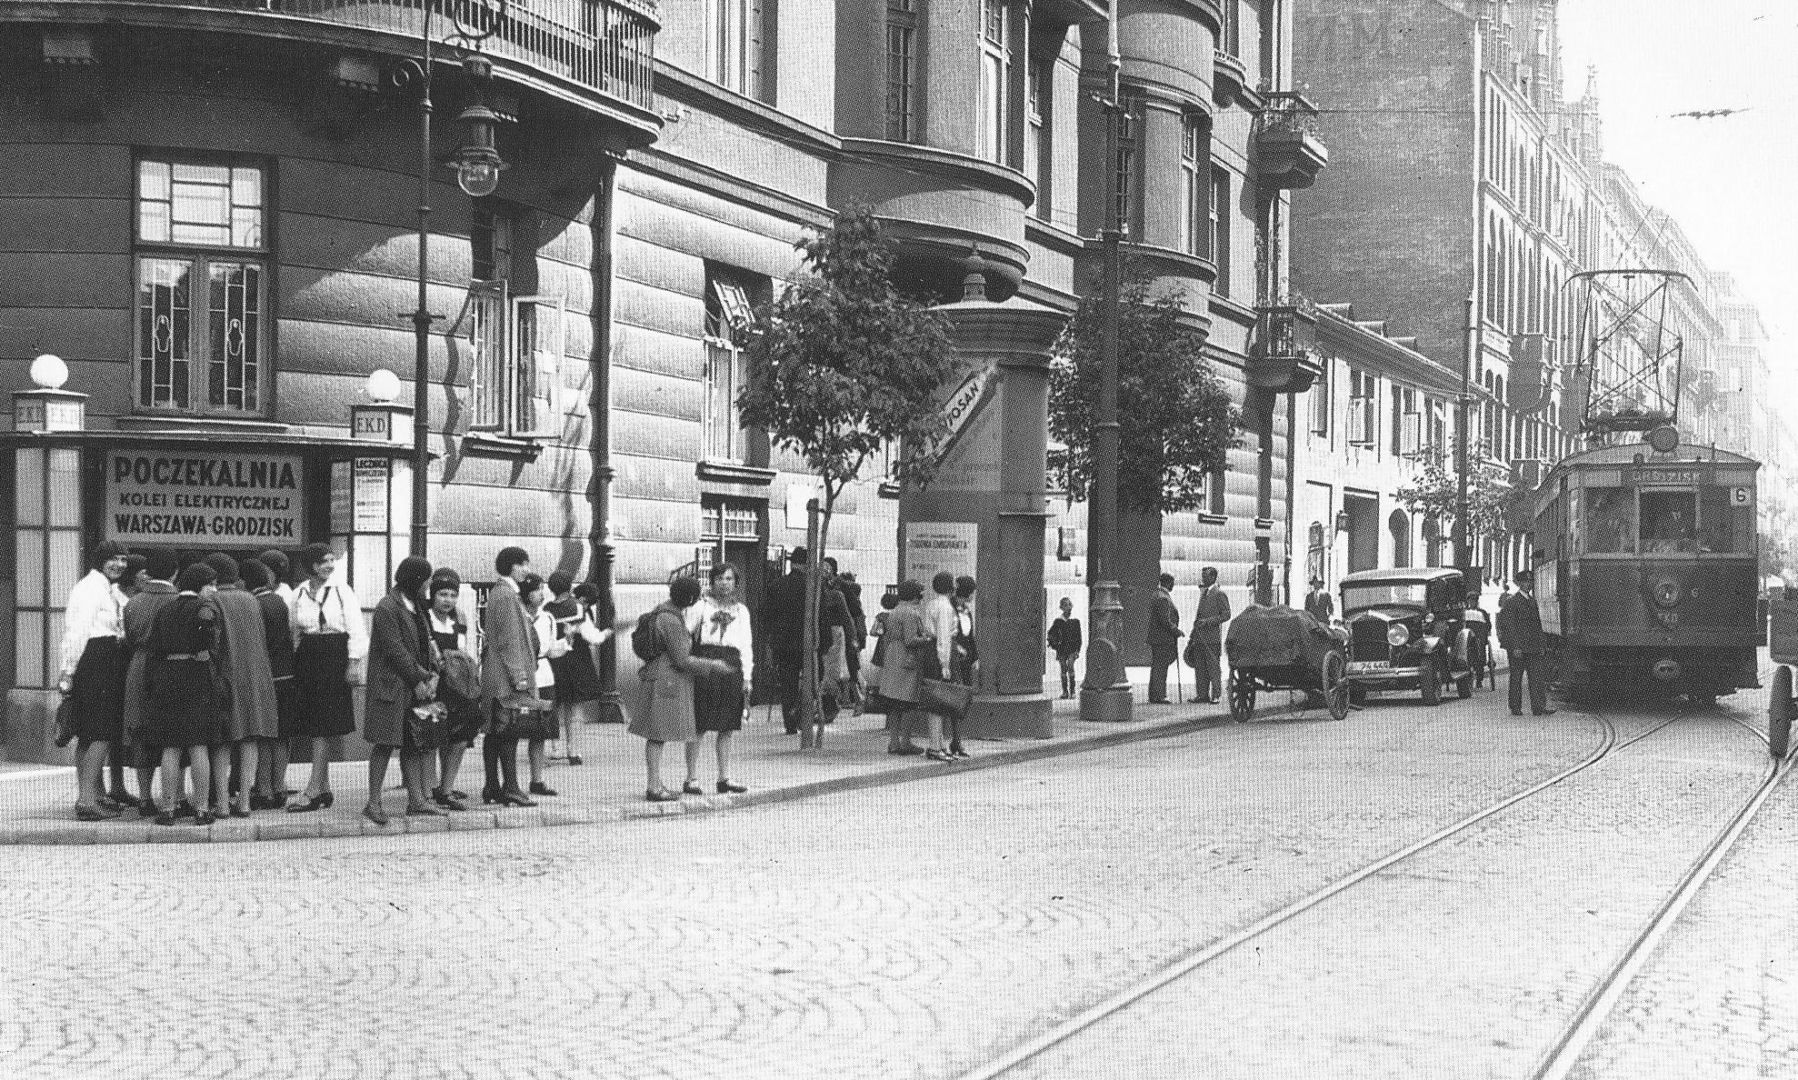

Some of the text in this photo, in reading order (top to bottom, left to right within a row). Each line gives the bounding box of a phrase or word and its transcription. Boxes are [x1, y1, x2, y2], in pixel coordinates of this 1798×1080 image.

[356, 417, 386, 433] EKD
[114, 457, 297, 489] POCZEKALNIA
[119, 492, 290, 511] KOLEI ELEKTRYCZNEJ
[1735, 487, 1746, 503] 6
[114, 514, 294, 537] WARSZAWA-GRODZISK
